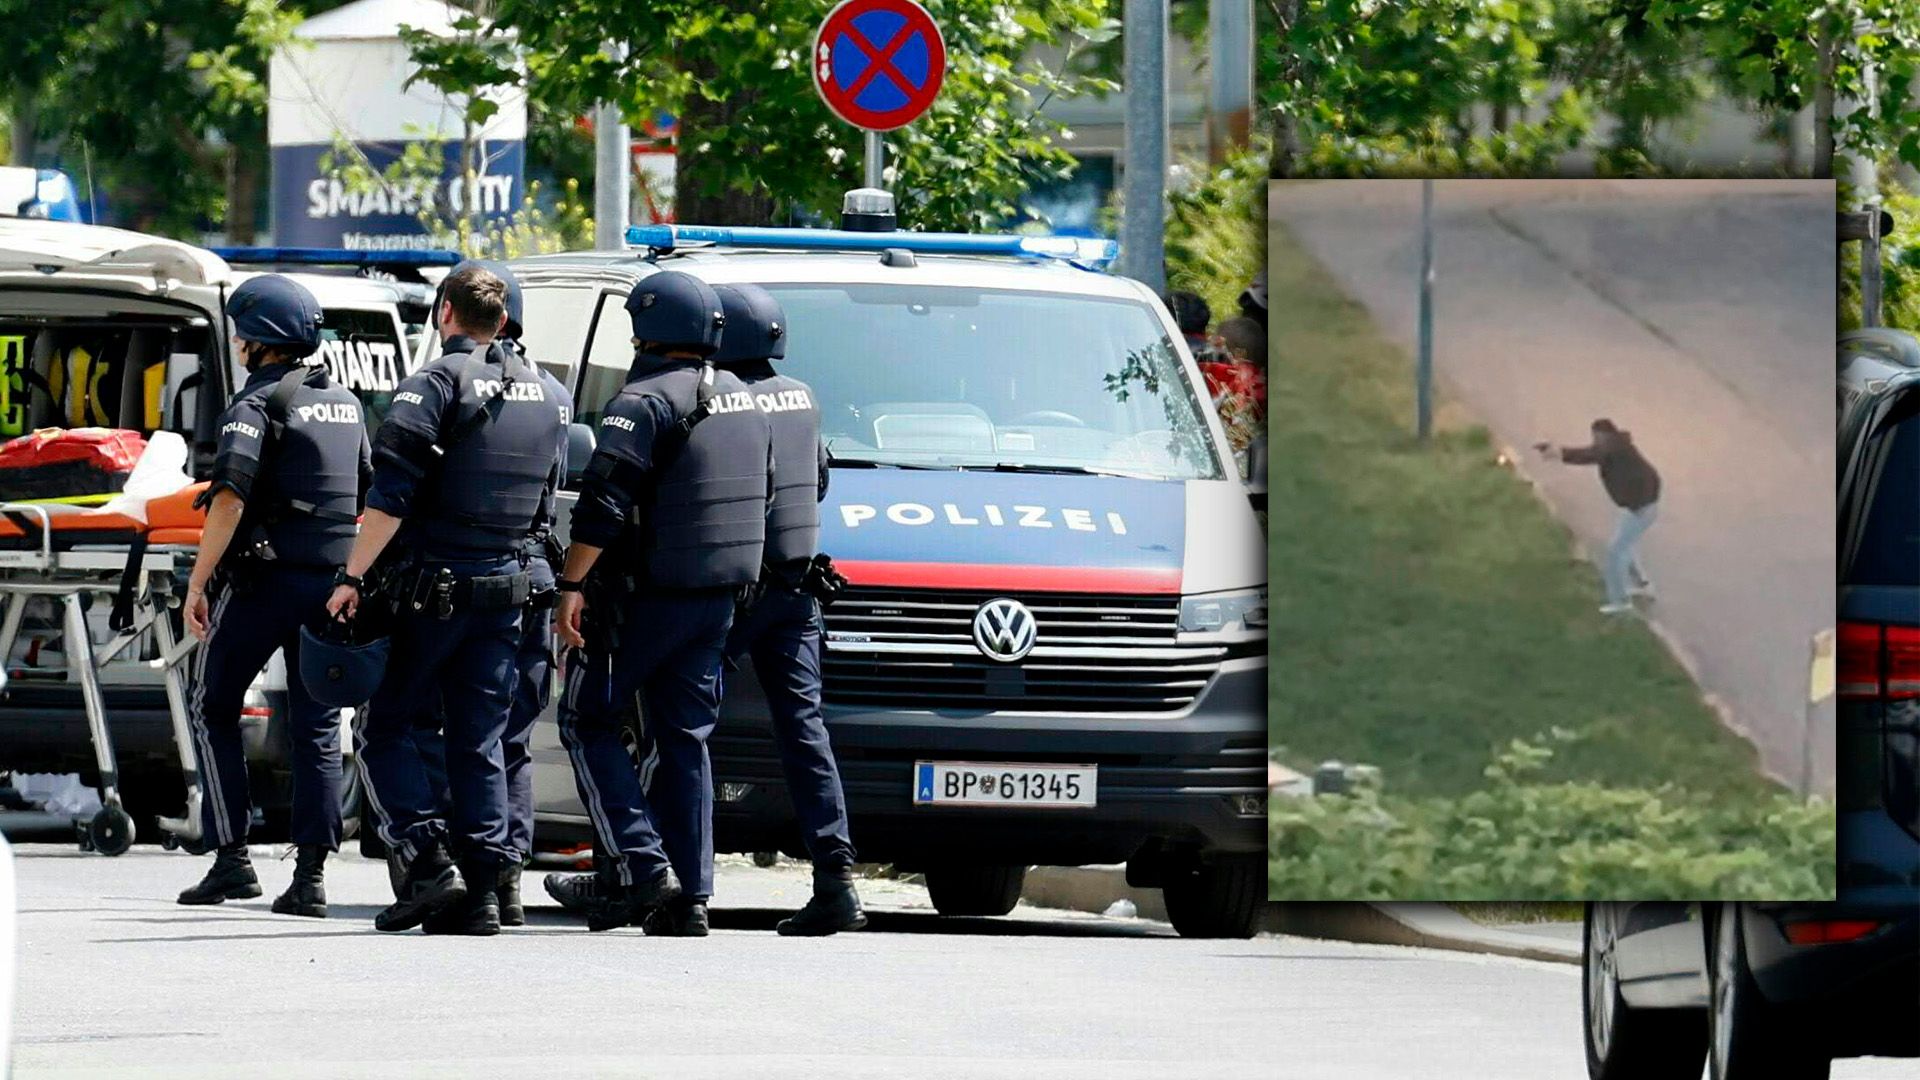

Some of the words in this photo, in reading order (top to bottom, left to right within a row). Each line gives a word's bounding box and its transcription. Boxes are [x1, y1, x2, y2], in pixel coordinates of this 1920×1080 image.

[449, 174, 513, 212] CITY
[472, 379, 545, 402] POLIZEI
[756, 390, 812, 413] OLIZEI
[298, 403, 359, 423] POLIZEI
[707, 391, 755, 414] OLIZEI
[222, 421, 260, 439] POLIZEI
[601, 415, 636, 432] POLIZEI
[839, 502, 1128, 536] POLIZEI
[945, 771, 977, 798] BP
[1000, 772, 1081, 800] 61345
